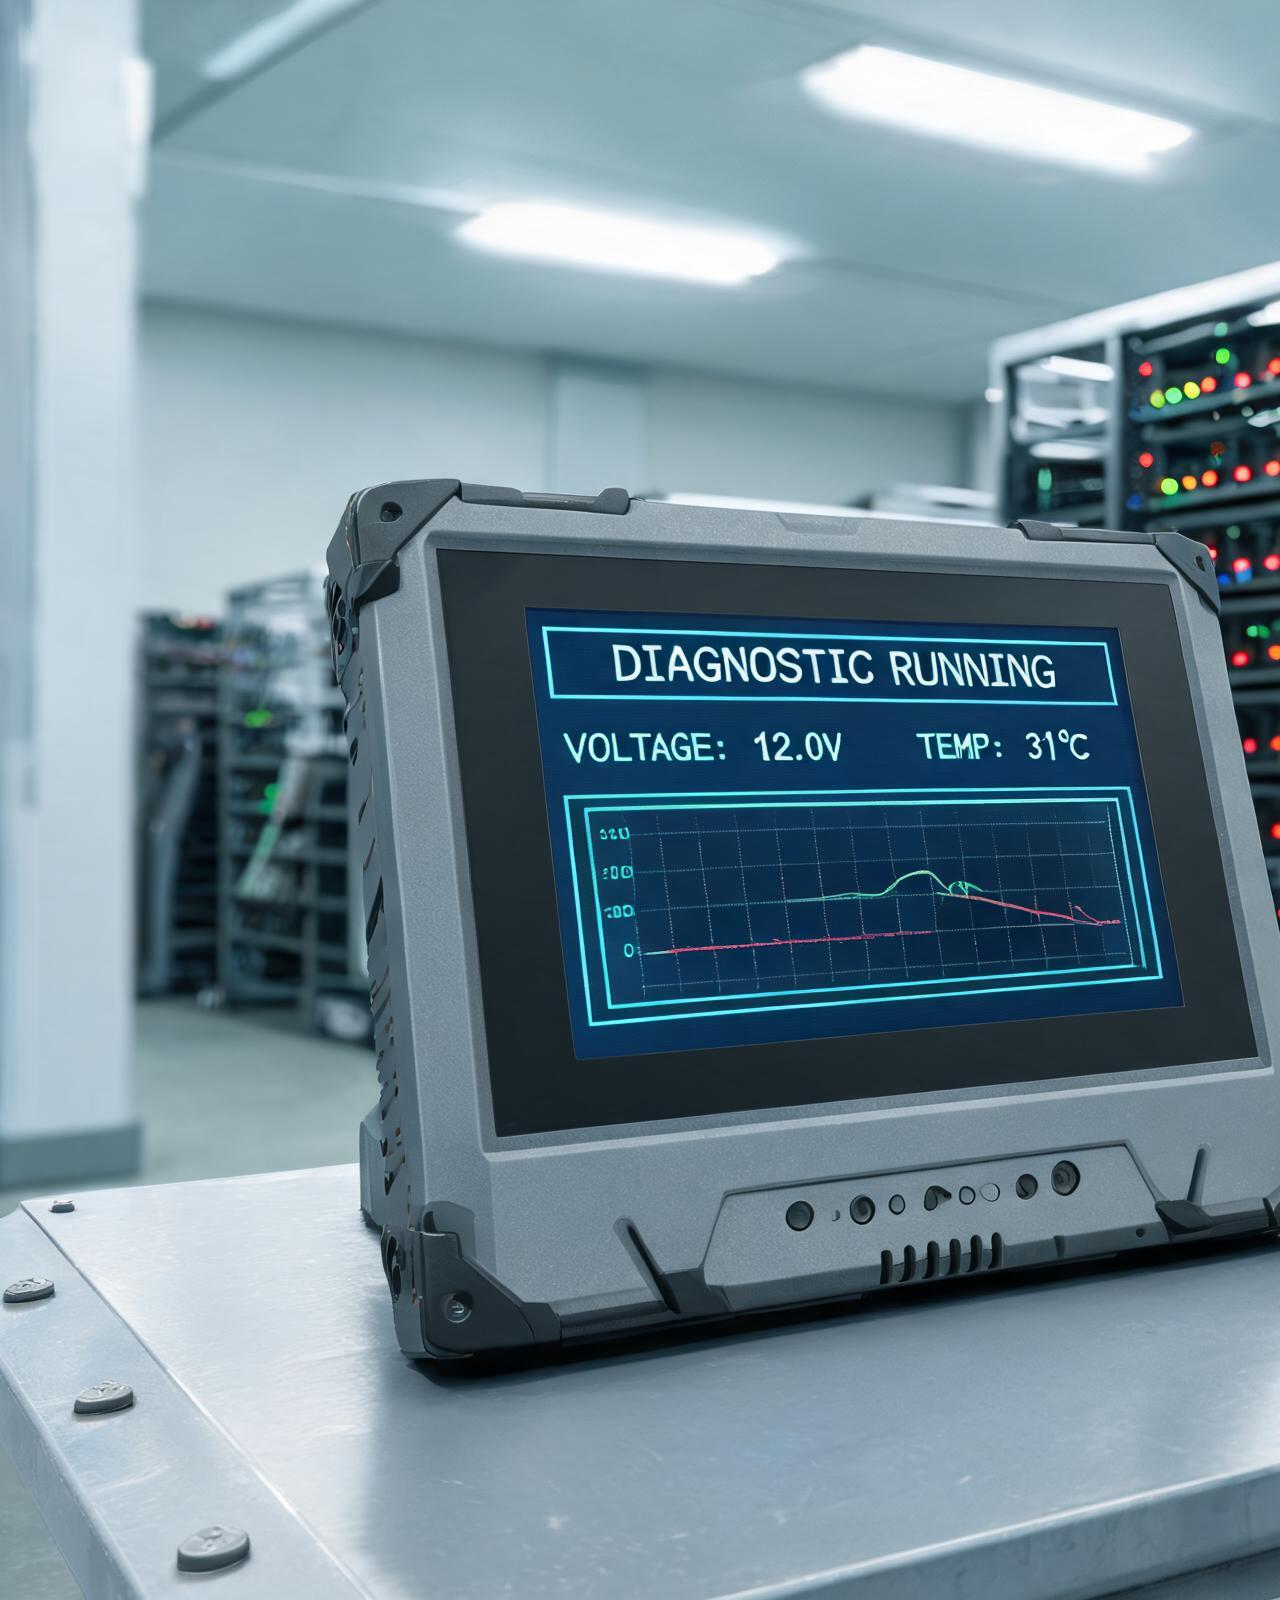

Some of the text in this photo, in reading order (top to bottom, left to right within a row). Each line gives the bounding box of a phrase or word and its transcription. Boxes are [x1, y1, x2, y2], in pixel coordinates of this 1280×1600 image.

[612, 644, 1056, 689] DIAGNOSTIC RUNNING
[563, 729, 1090, 763] VOLTAGE: 12.0V TEMP: 31°C
